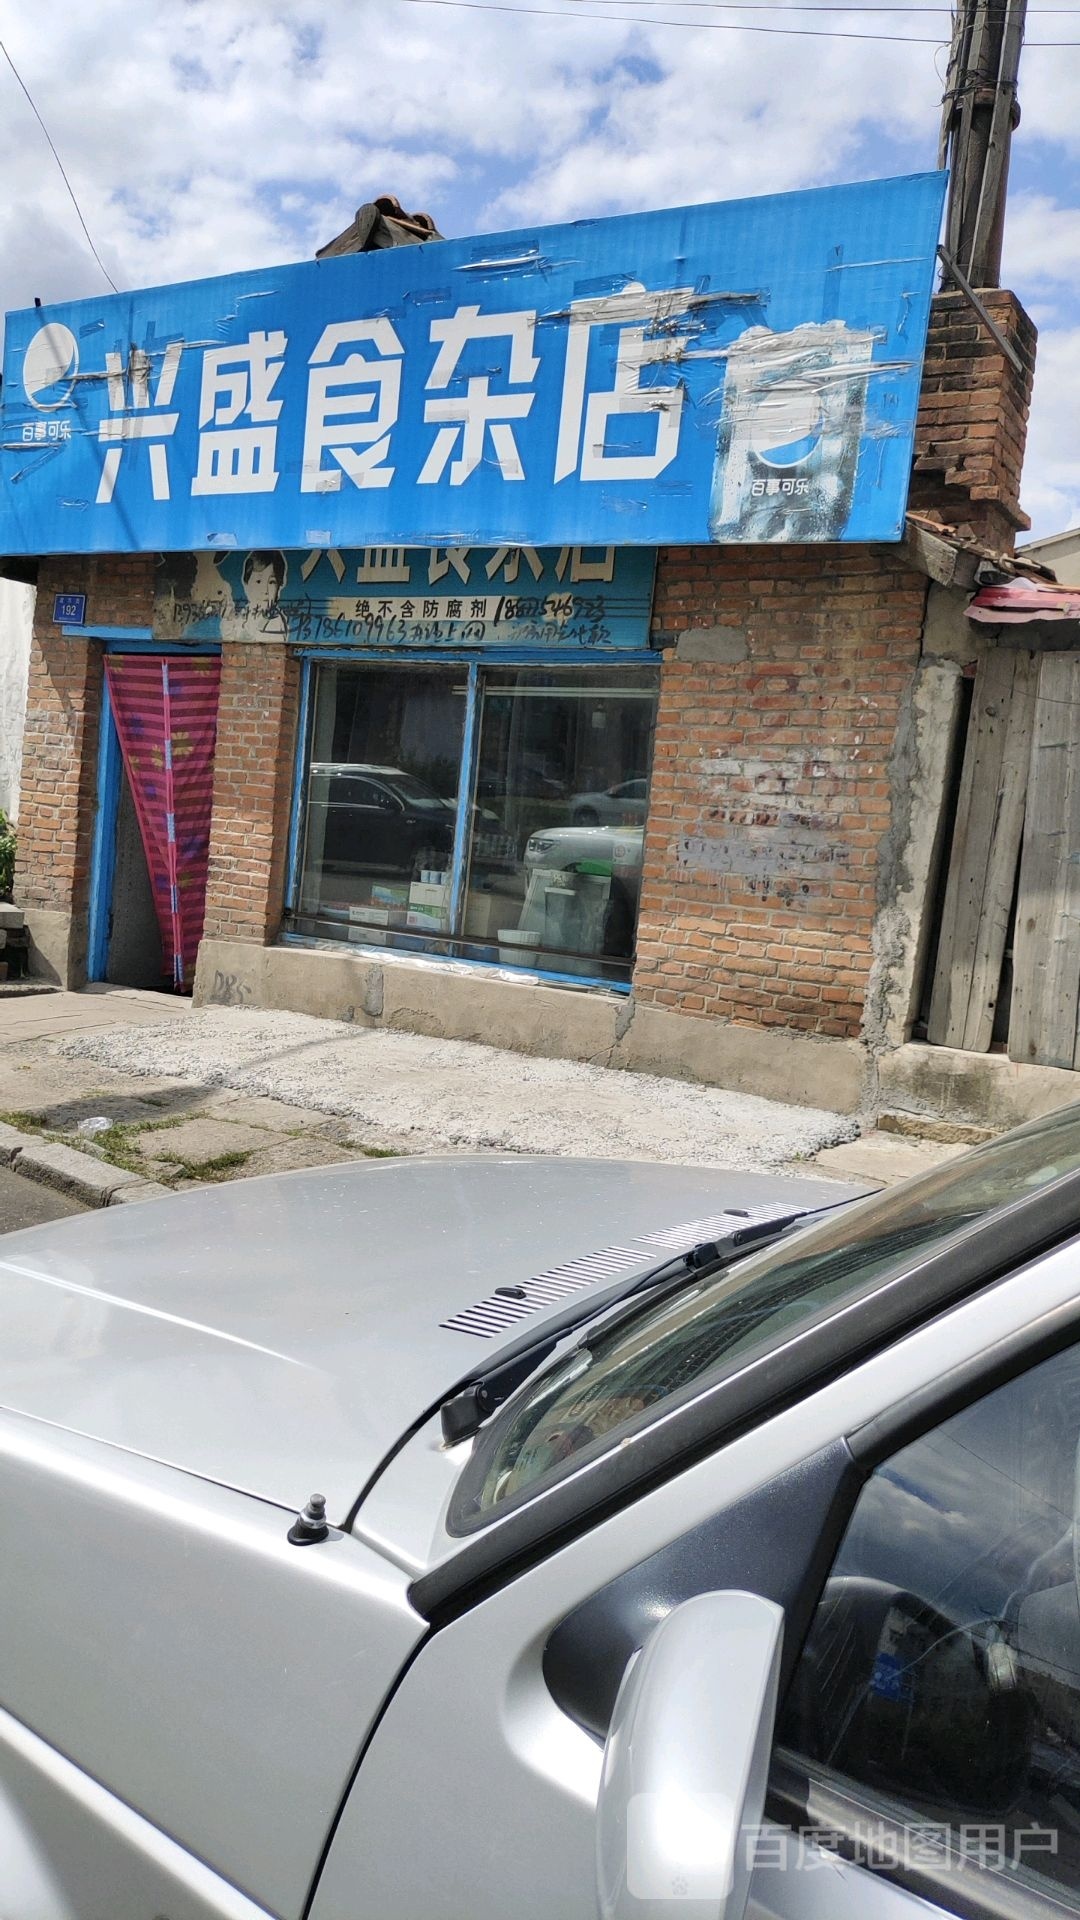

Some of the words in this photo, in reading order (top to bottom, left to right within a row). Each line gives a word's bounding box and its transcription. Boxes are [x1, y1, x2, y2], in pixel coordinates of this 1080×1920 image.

[95, 282, 694, 503] 兴盛食杂店
[22, 420, 72, 442] 百事可乐
[751, 478, 809, 496] 百事可乐
[62, 604, 77, 616] 192
[355, 599, 487, 619] 绝不含防腐剂
